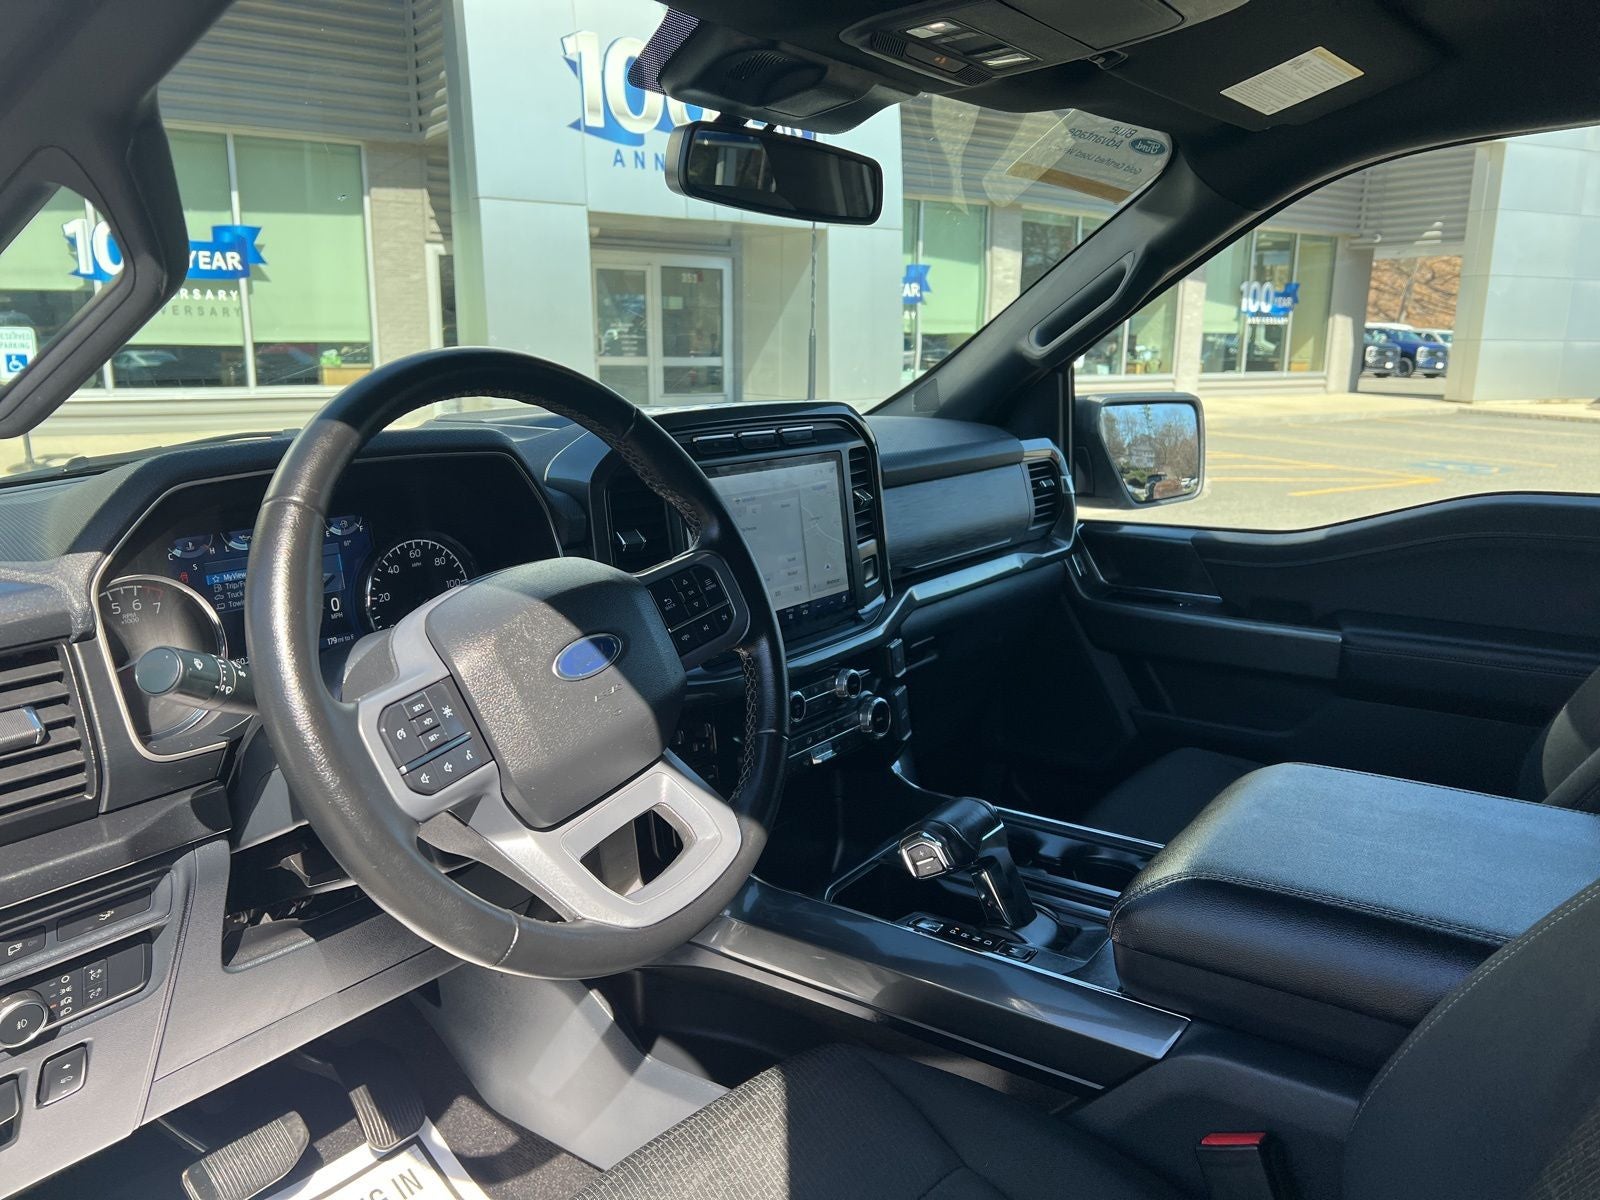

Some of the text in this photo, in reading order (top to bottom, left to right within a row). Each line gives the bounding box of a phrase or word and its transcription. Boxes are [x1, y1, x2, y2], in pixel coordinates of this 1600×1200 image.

[561, 30, 720, 134] 10
[63, 219, 124, 276] 10
[189, 250, 243, 271] YEAR
[1240, 280, 1274, 313] 100
[209, 547, 216, 555] H
[409, 549, 421, 558] 60
[167, 553, 174, 561] C
[434, 557, 446, 566] 80
[387, 565, 400, 574] 40
[223, 571, 247, 581] MyView
[446, 578, 460, 589] 100
[379, 592, 391, 603] 20
[111, 602, 121, 615] 5
[132, 598, 142, 611] 6
[152, 601, 161, 615] 7
[330, 597, 340, 612] 0
[331, 612, 343, 620] MPH
[327, 636, 338, 645] 179
[412, 703, 425, 712] SET+
[391, 1168, 424, 1200] IN
